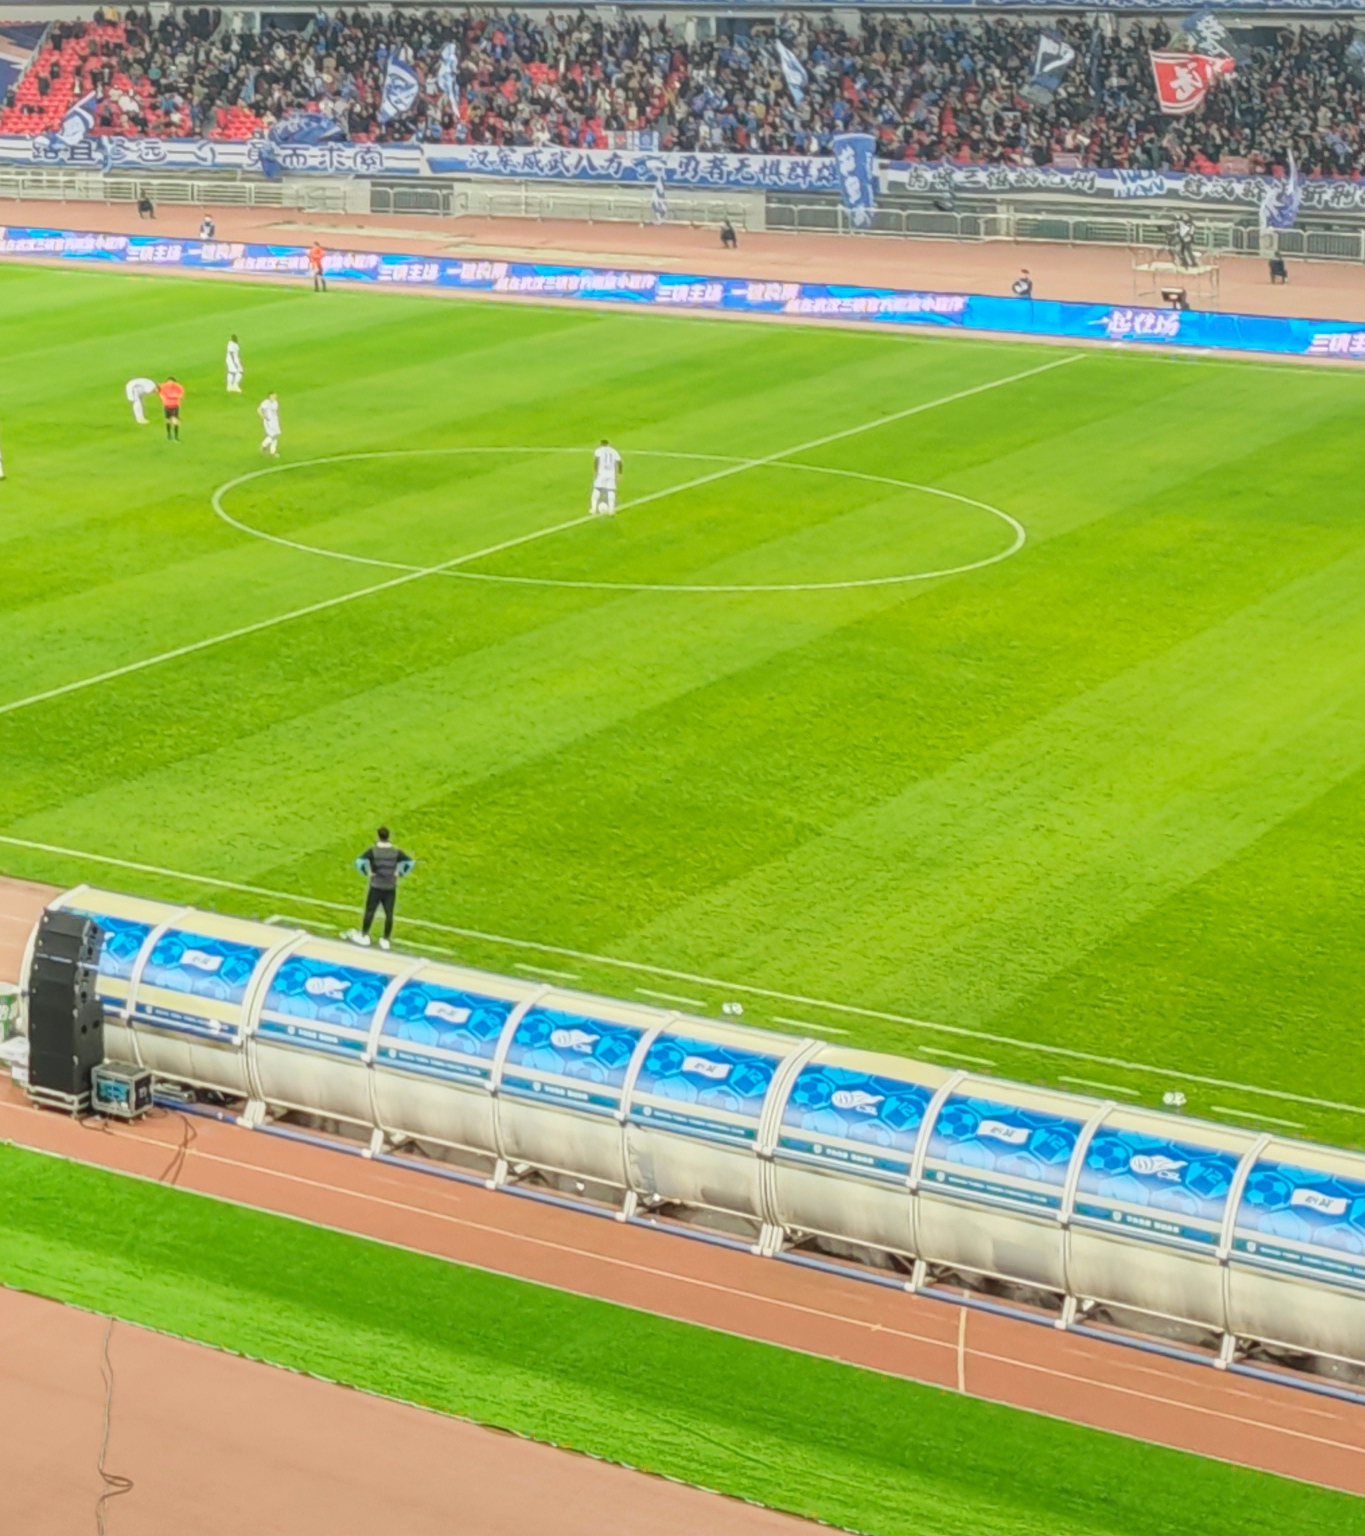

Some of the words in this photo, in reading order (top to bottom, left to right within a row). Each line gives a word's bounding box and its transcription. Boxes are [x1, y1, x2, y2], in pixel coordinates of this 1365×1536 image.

[466, 147, 625, 178] 汉军威武八方
